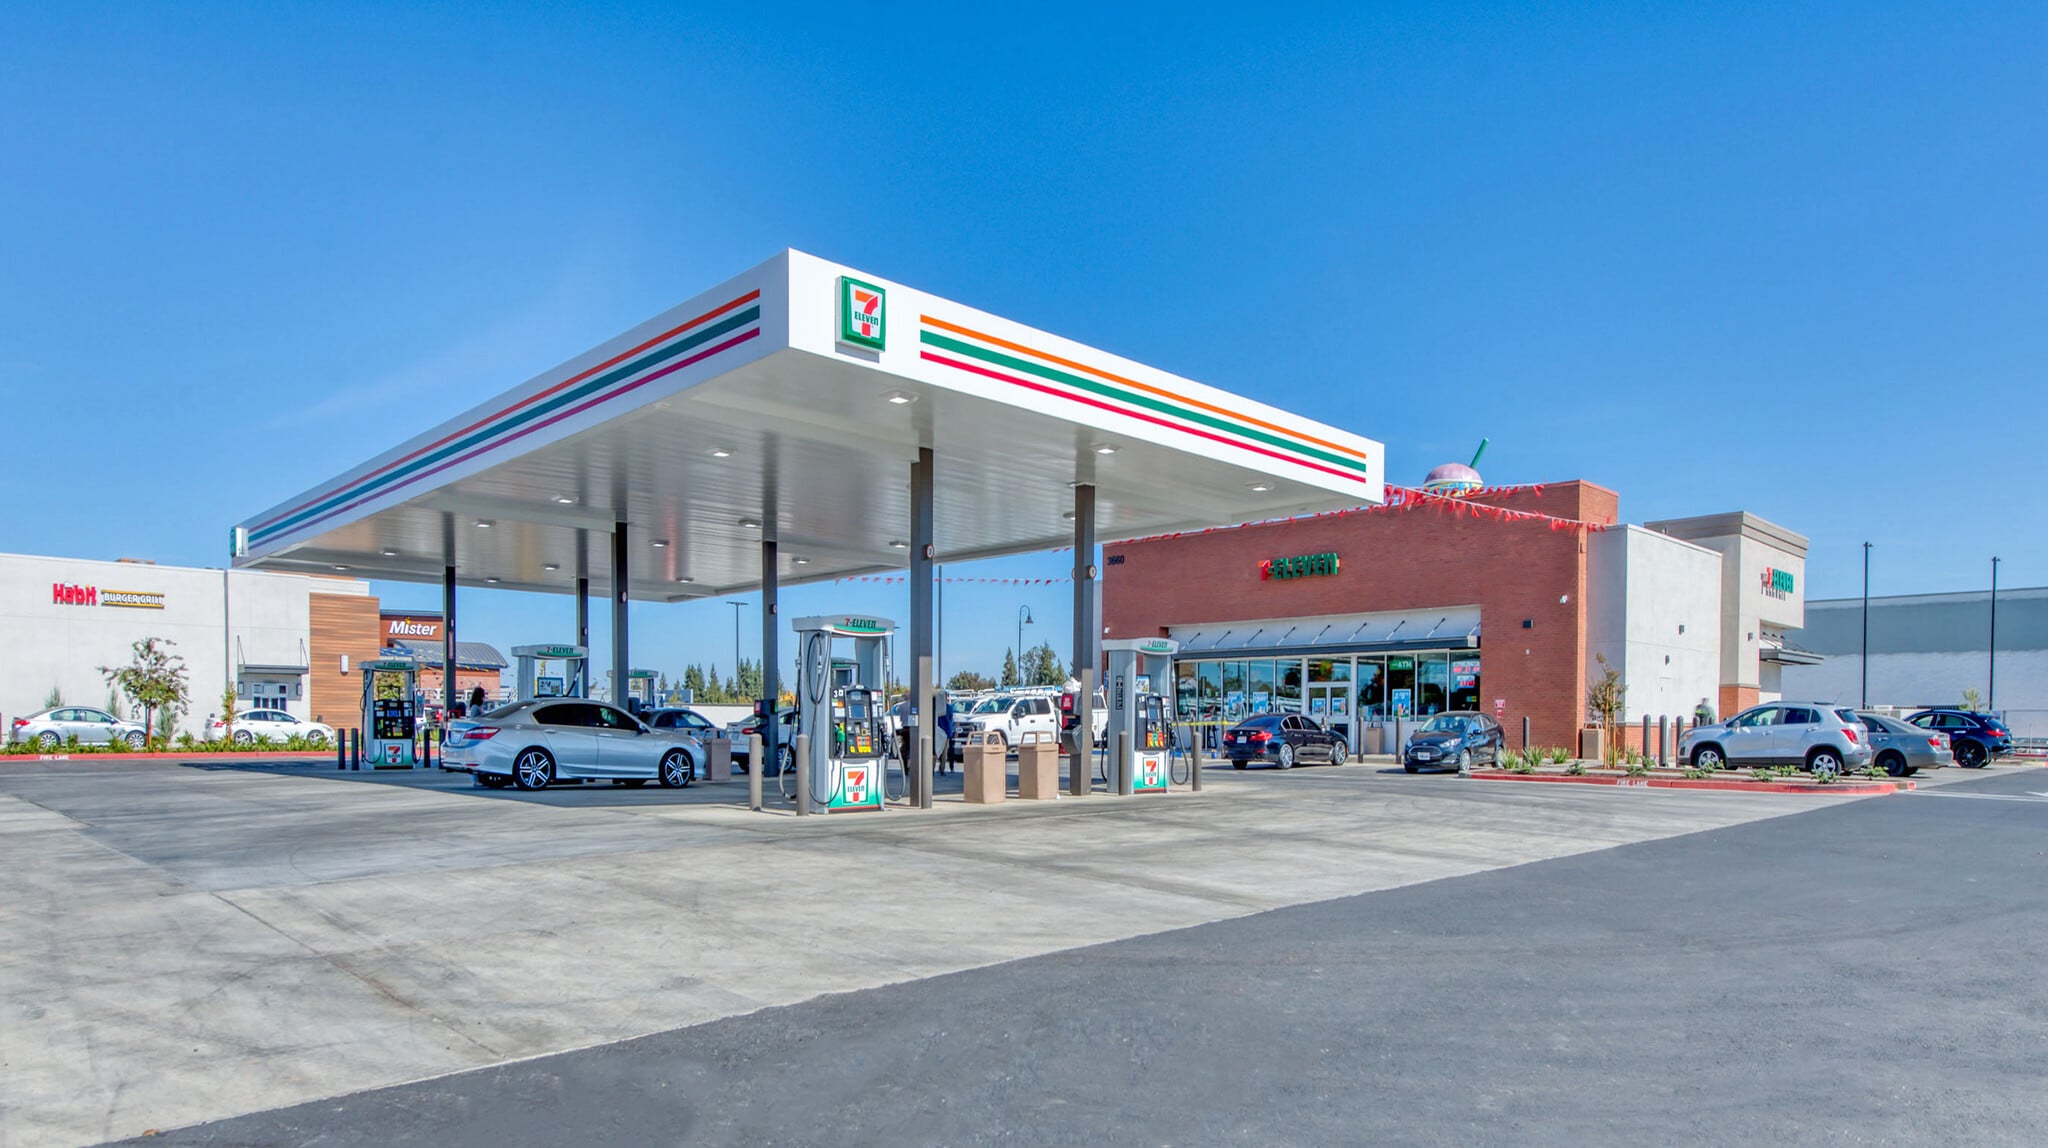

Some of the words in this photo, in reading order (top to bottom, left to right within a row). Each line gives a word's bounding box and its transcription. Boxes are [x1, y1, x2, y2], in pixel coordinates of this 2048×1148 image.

[855, 290, 878, 336] 7
[53, 582, 97, 605] Habit
[104, 592, 138, 604] BURGER
[140, 594, 163, 604] GRILL
[389, 617, 437, 636] Mister
[1146, 761, 1157, 785] 7
[847, 770, 865, 802] 7
